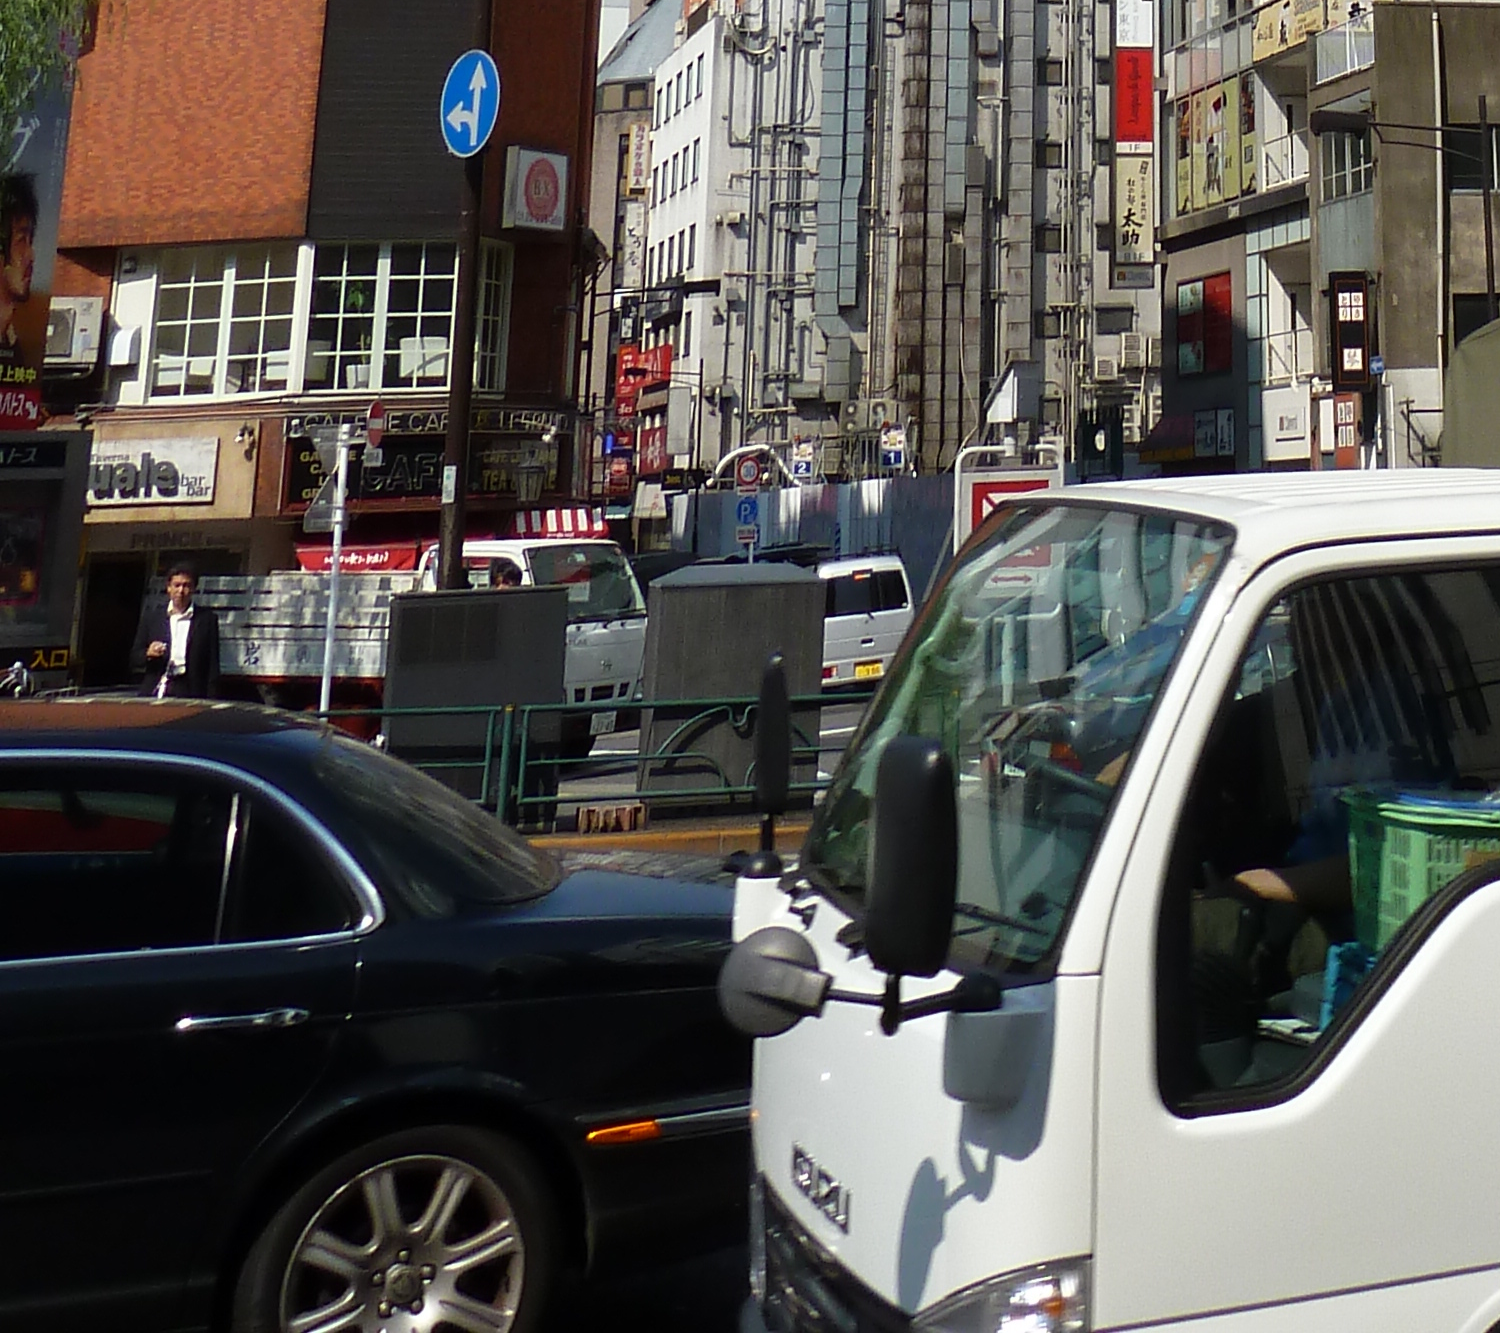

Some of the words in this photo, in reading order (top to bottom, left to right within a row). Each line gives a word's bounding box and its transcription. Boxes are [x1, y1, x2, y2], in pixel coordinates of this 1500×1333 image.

[1121, 207, 1144, 248] 太助
[0, 363, 37, 384] 上映中
[888, 454, 895, 465] 1
[363, 452, 446, 492] CAF
[799, 463, 807, 474] 2
[180, 474, 206, 488] bar
[186, 484, 211, 498] bar
[30, 649, 69, 669] 入口
